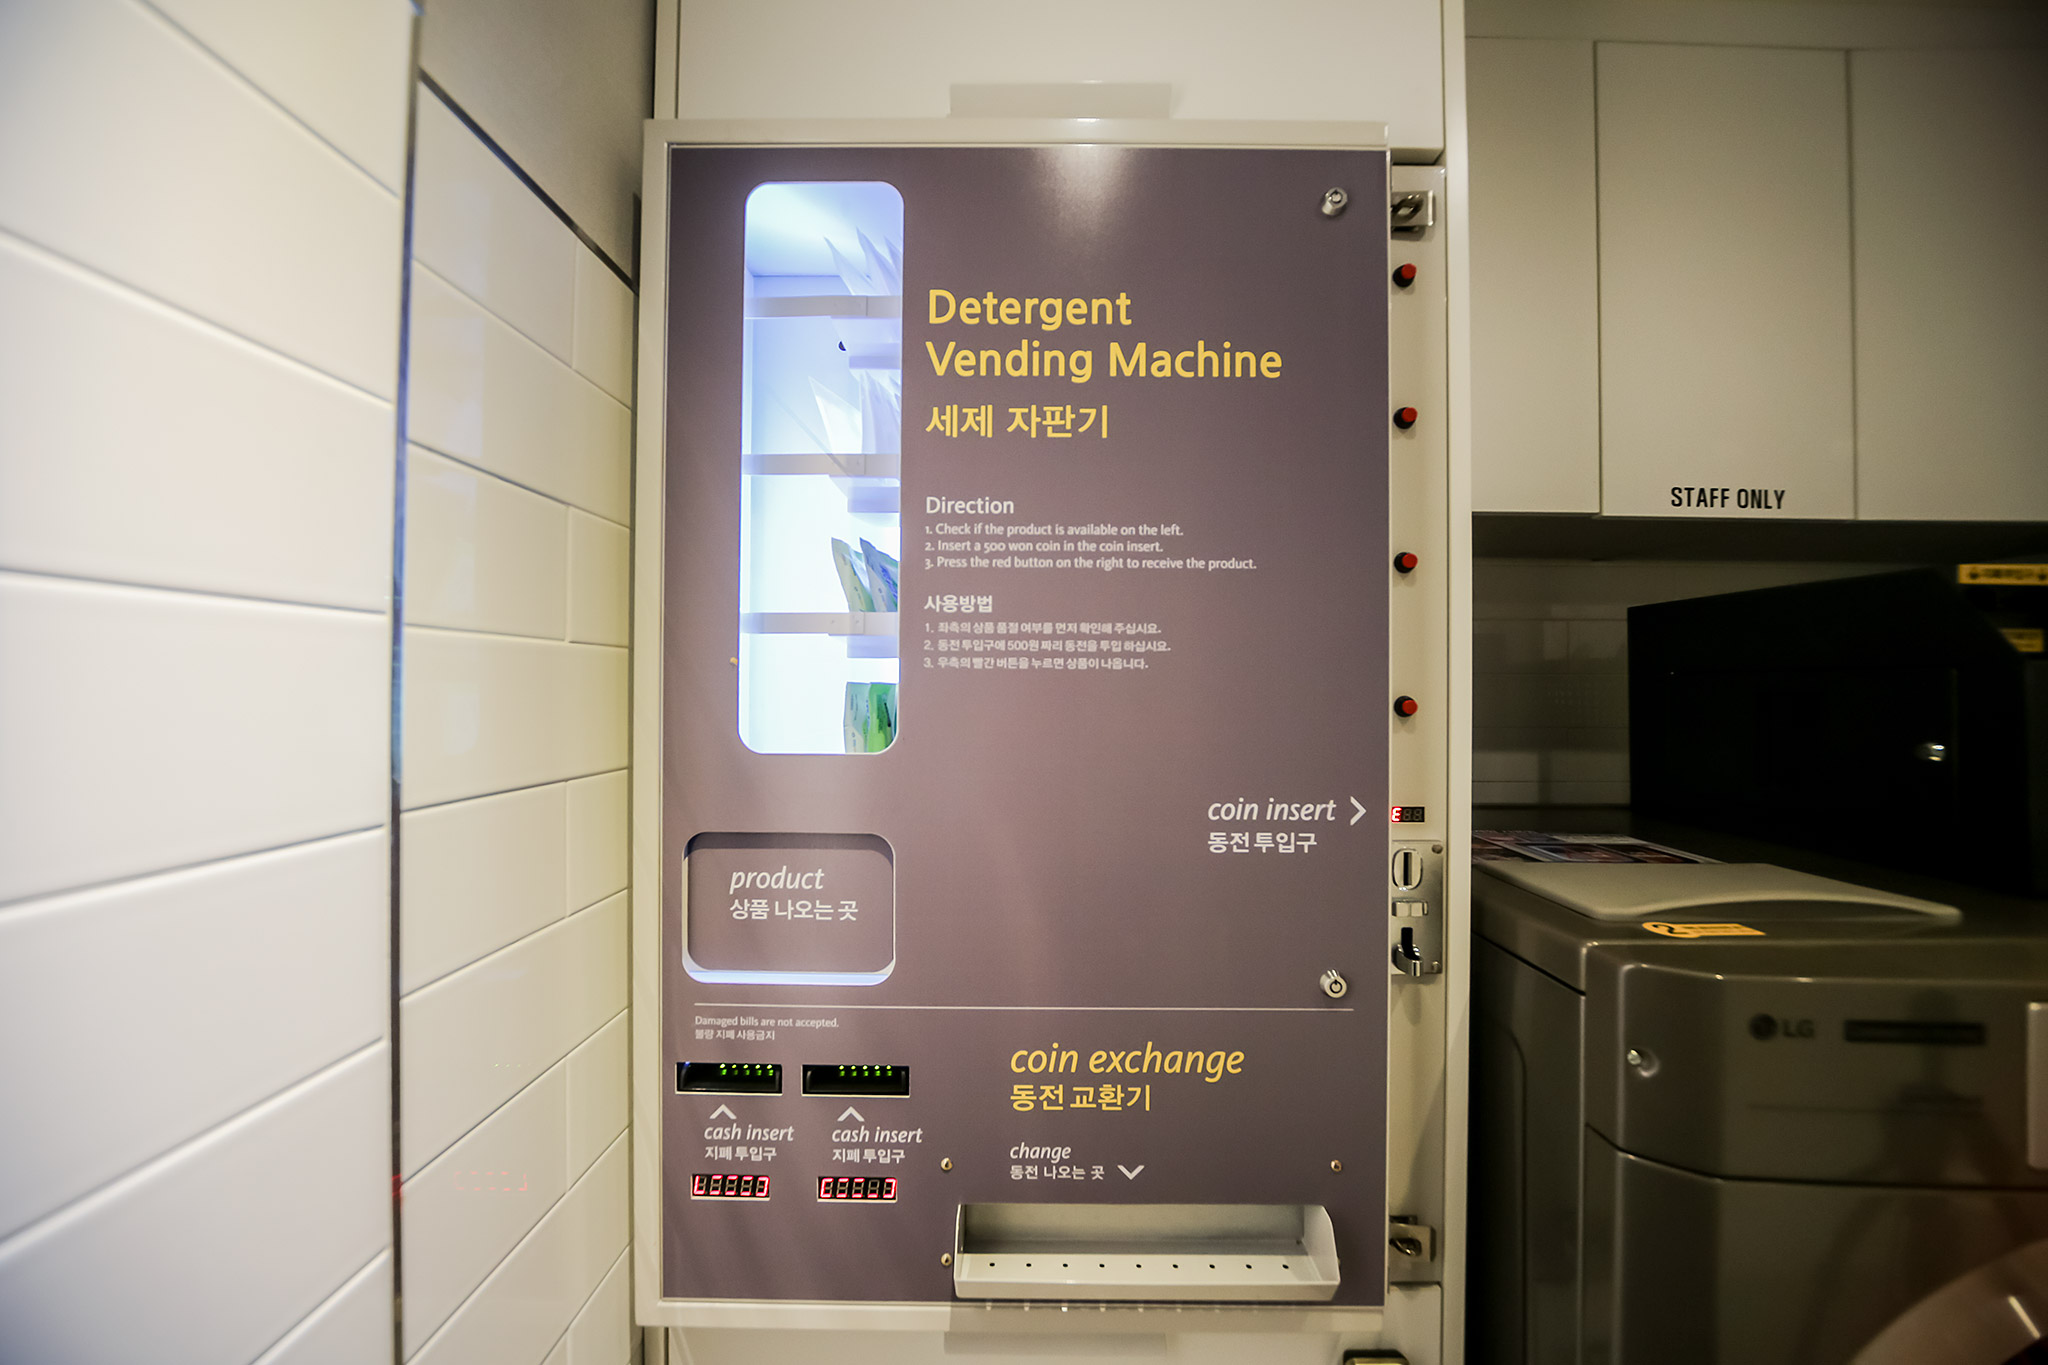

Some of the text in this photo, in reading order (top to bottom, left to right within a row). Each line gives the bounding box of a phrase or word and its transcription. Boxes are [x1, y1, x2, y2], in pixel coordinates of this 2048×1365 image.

[928, 288, 1132, 331] Detergent
[925, 339, 1283, 384] Vending Machine
[925, 404, 1109, 439] 세제 자판기
[926, 496, 1014, 514] Direction
[1670, 486, 1785, 510] STAFF ONLY
[925, 522, 1184, 538] 1. Check if the product is available on the left.
[924, 540, 1164, 554] 2. Insert a 500 won coin in the coin insert.
[924, 556, 1257, 571] 3. Press the red button on the right to receive the product.
[923, 594, 993, 613] 사용방법
[924, 622, 935, 633] 1.
[938, 621, 971, 634] 좌측의
[972, 621, 995, 634] 상품
[996, 621, 1019, 634] 품절
[1020, 621, 1053, 635] 여부를
[1055, 622, 1077, 635] 먼저
[1079, 622, 1113, 635] 확인해
[923, 639, 935, 651] 2.
[938, 639, 960, 652] 동전
[961, 639, 1006, 652] 투입구에
[1007, 640, 1039, 652] 500원
[1040, 640, 1063, 652] 짜리
[1065, 640, 1097, 653] 동전을
[1099, 640, 1122, 653] 투입
[923, 656, 1149, 670] 3. 우측의 빨간 버튼을 누르면 상품이 나옵니다.
[1207, 797, 1337, 821] coin insert
[1207, 832, 1318, 853] 동전 투입구
[729, 865, 825, 895] product
[729, 899, 859, 921] 상품 나오는 곳
[694, 1015, 840, 1030] Damaged bills are not accepted.
[1783, 1019, 1815, 1039] LG
[715, 1029, 735, 1040] 지폐
[736, 1030, 775, 1041] 사용금지
[1010, 1041, 1246, 1083] coin exchange
[1010, 1083, 1150, 1112] 동전 교환기
[704, 1123, 795, 1142] cash insert
[832, 1126, 923, 1144] cash insert
[704, 1145, 777, 1162] 지폐 투입구
[832, 1148, 906, 1164] 지폐 투입구
[1009, 1142, 1072, 1163] change
[1009, 1165, 1105, 1181] 동전 나오는 곳
